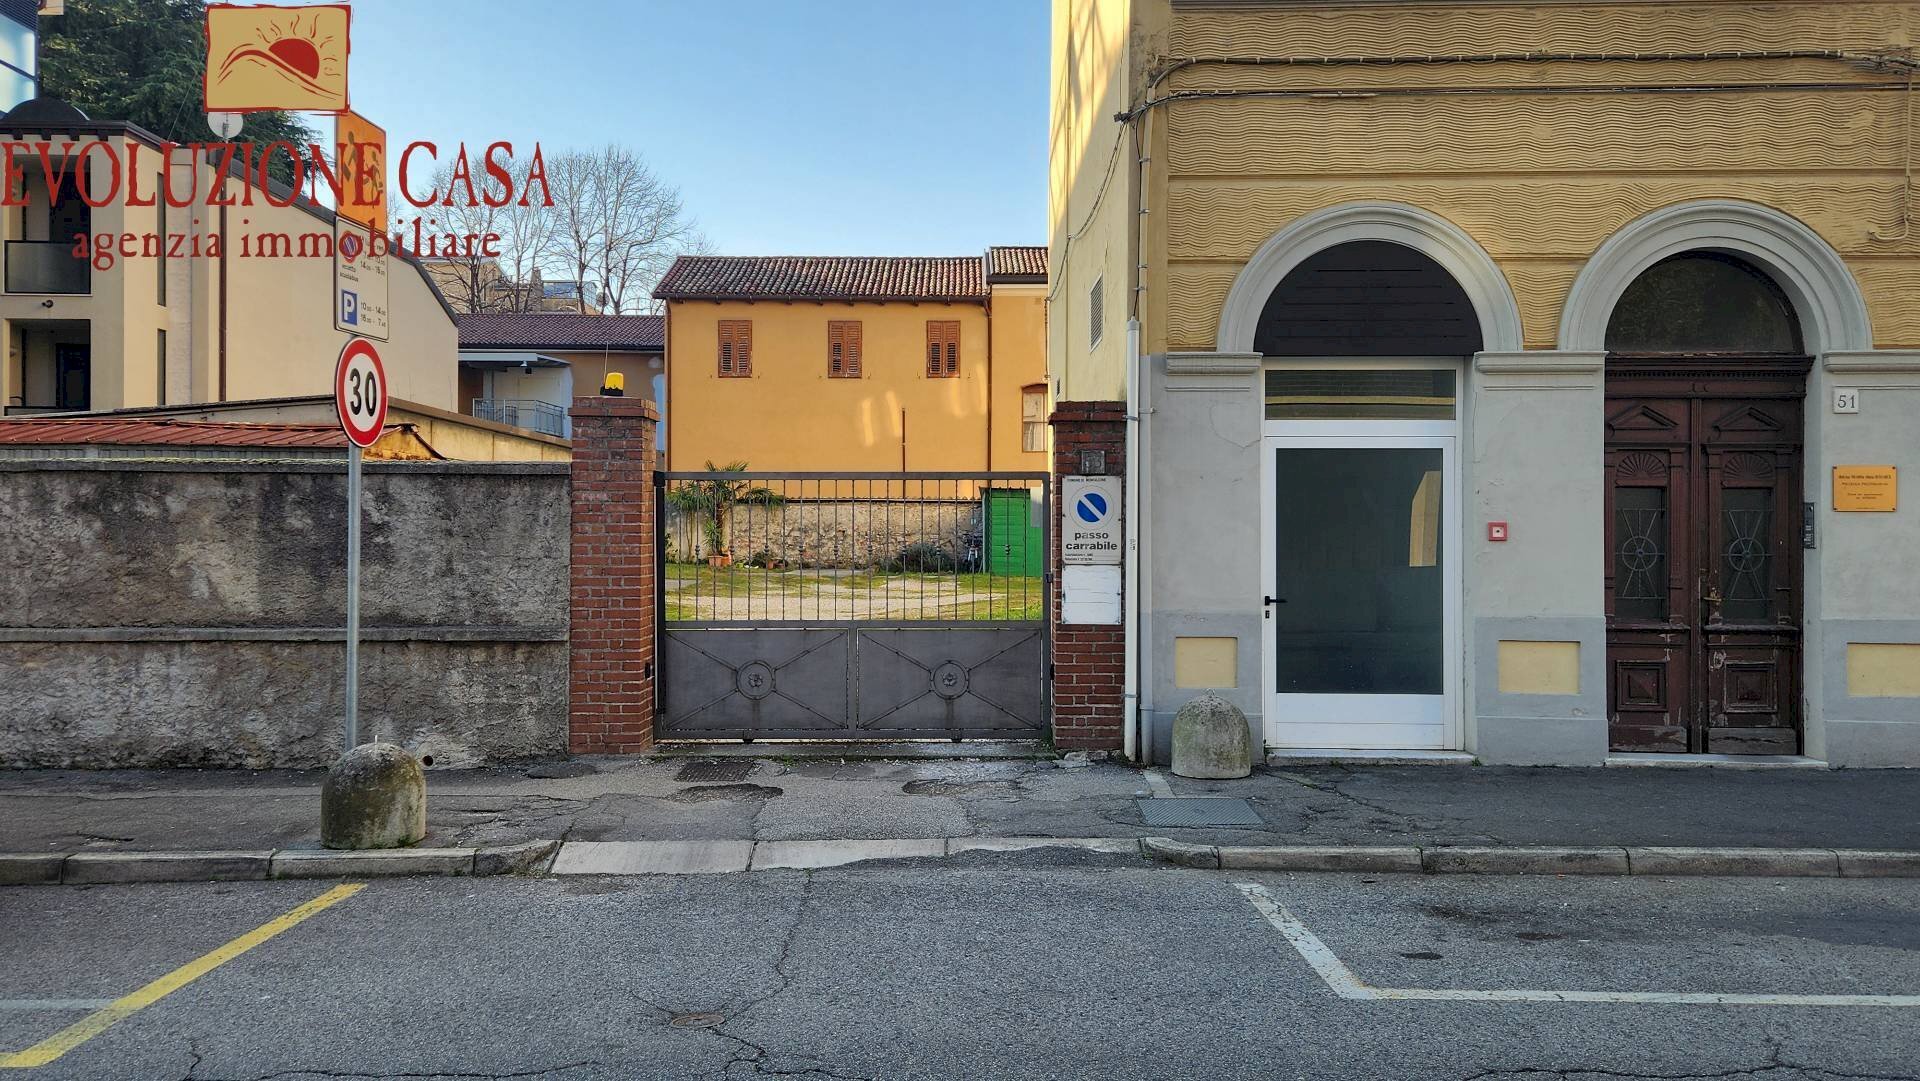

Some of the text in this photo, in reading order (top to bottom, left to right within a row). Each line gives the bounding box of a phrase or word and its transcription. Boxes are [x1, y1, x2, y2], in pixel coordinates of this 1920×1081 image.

[343, 292, 355, 321] P
[350, 368, 377, 417] 30
[1837, 394, 1856, 409] 51
[1074, 532, 1109, 541] passo
[1066, 541, 1118, 550] carrabile
